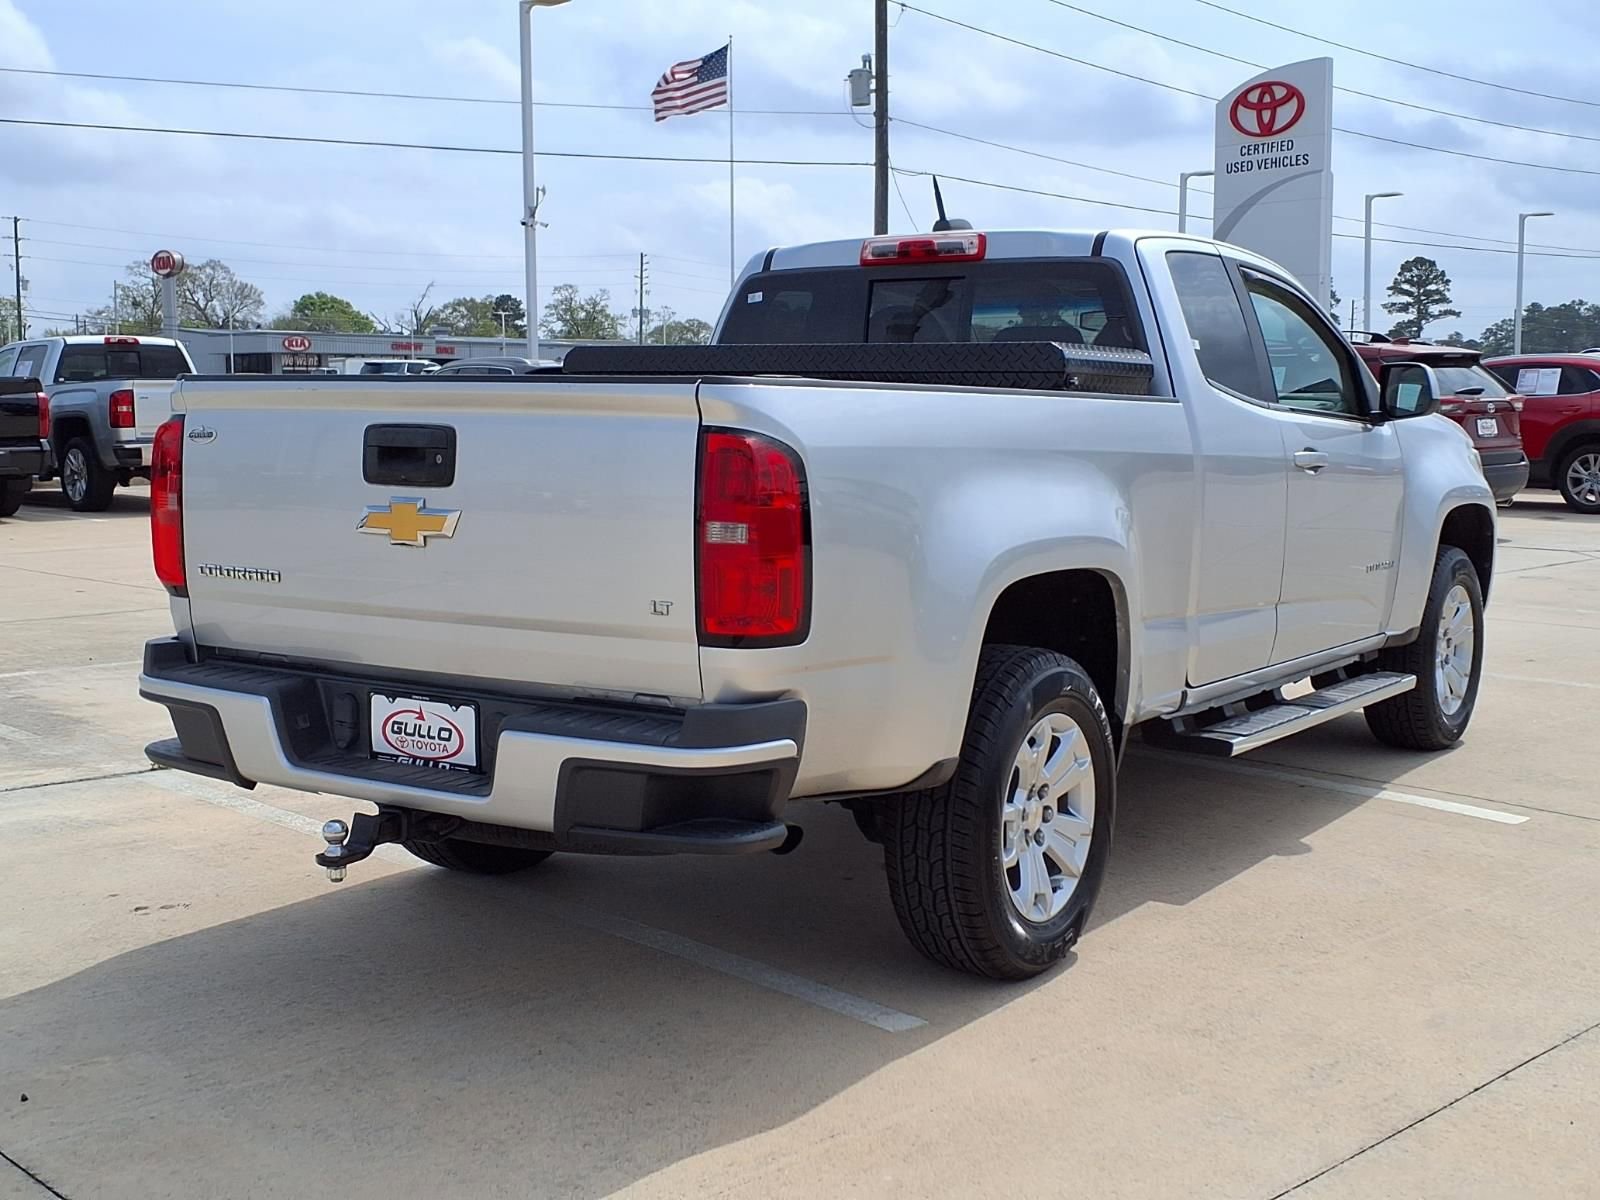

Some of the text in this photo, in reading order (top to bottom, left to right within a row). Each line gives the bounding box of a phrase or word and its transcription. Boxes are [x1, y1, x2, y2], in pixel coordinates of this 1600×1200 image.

[1240, 139, 1294, 157] CERTIFIED
[1226, 153, 1310, 174] USED VEHICLES
[286, 338, 307, 348] KIA
[197, 563, 282, 583] COLORADO
[650, 599, 674, 616] LT
[390, 719, 453, 742] GULLO
[410, 739, 449, 753] TOYOTA
